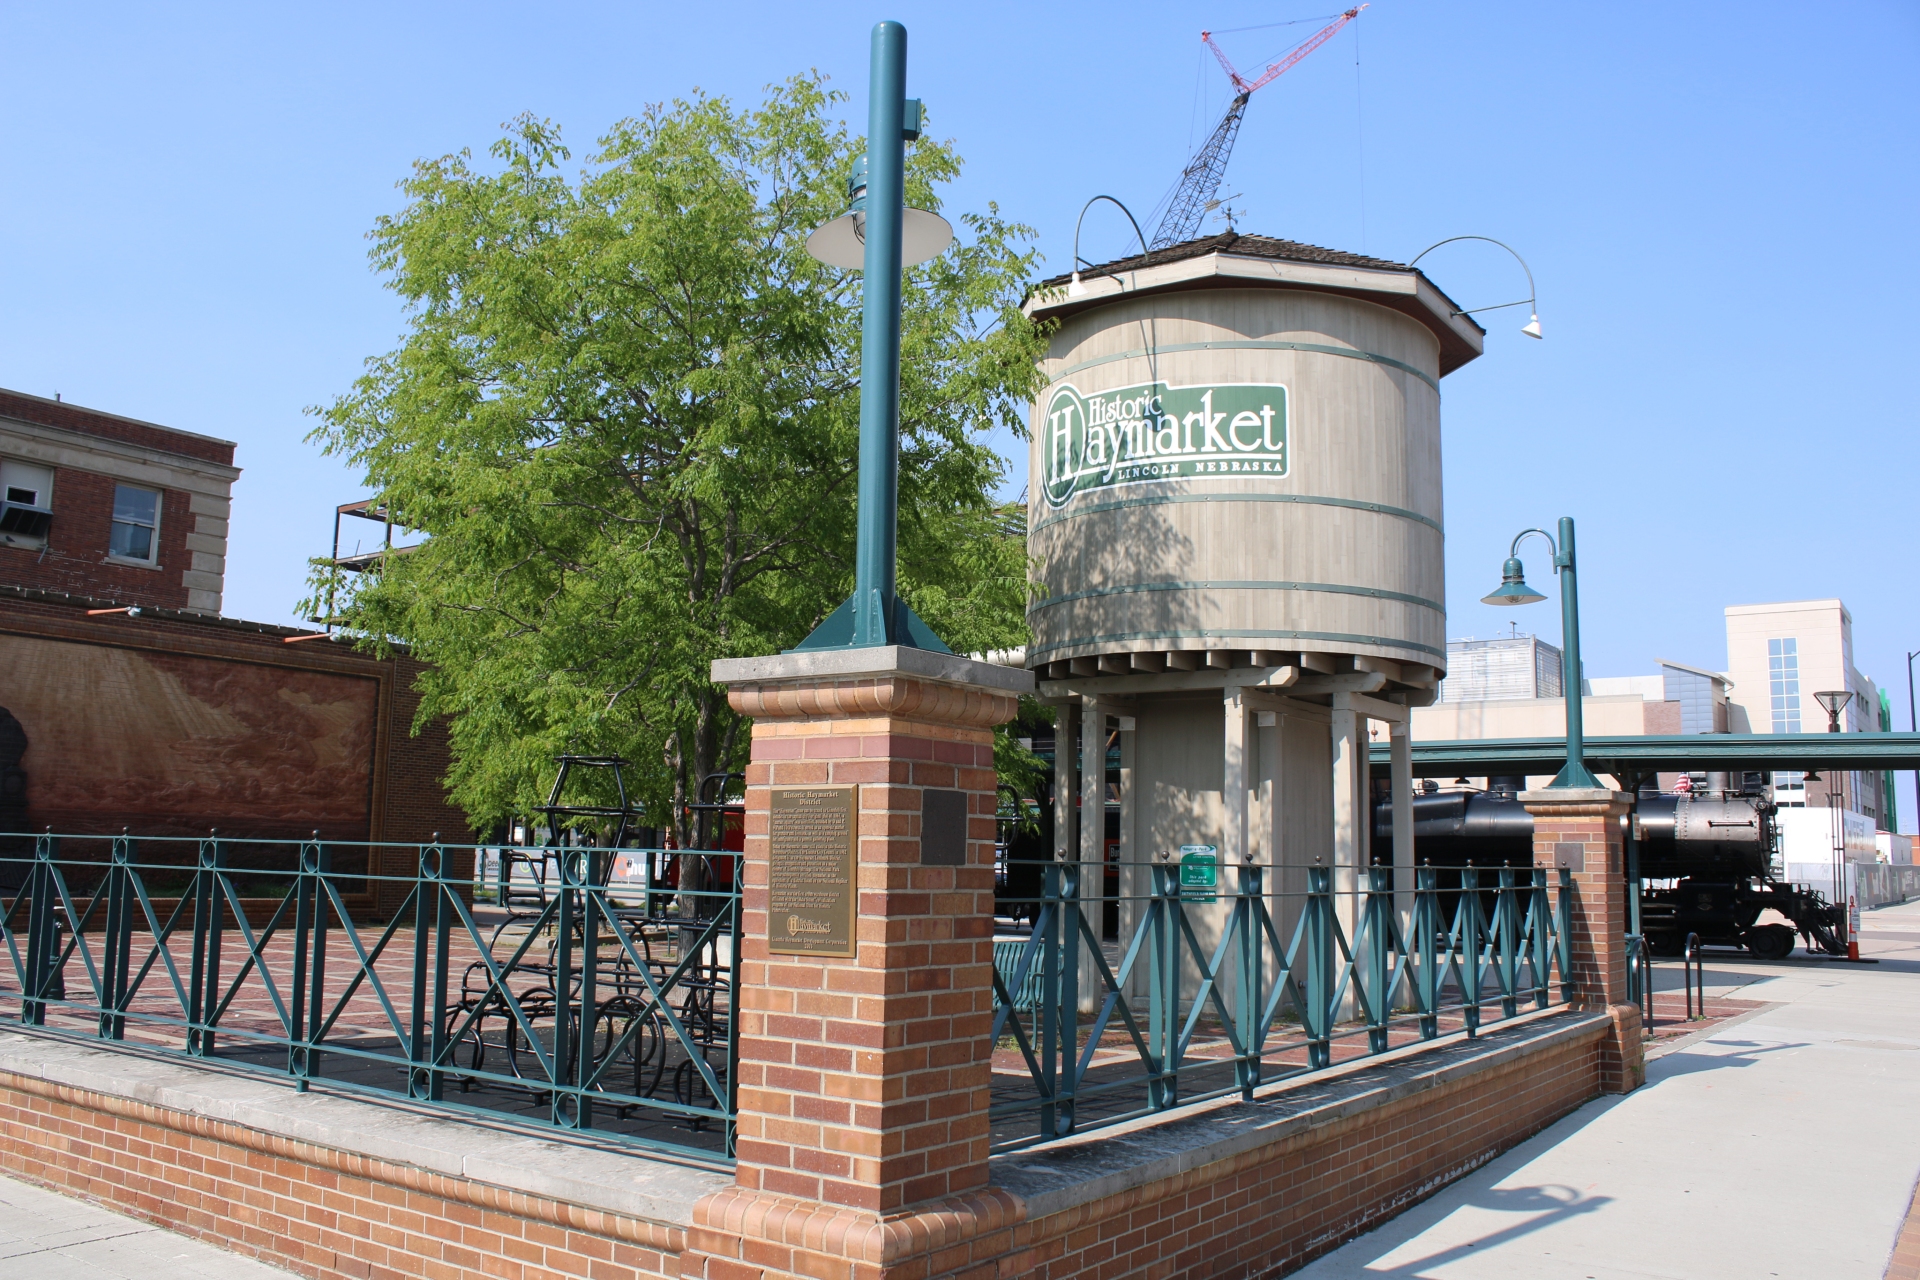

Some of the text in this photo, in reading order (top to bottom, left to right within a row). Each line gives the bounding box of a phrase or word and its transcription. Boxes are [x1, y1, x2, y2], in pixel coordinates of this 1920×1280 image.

[1088, 390, 1163, 426] Historic
[1049, 389, 1283, 487] Haymarket
[1118, 461, 1283, 480] LINCOLN NEBRASKA
[783, 791, 839, 800] Historic Haymarket
